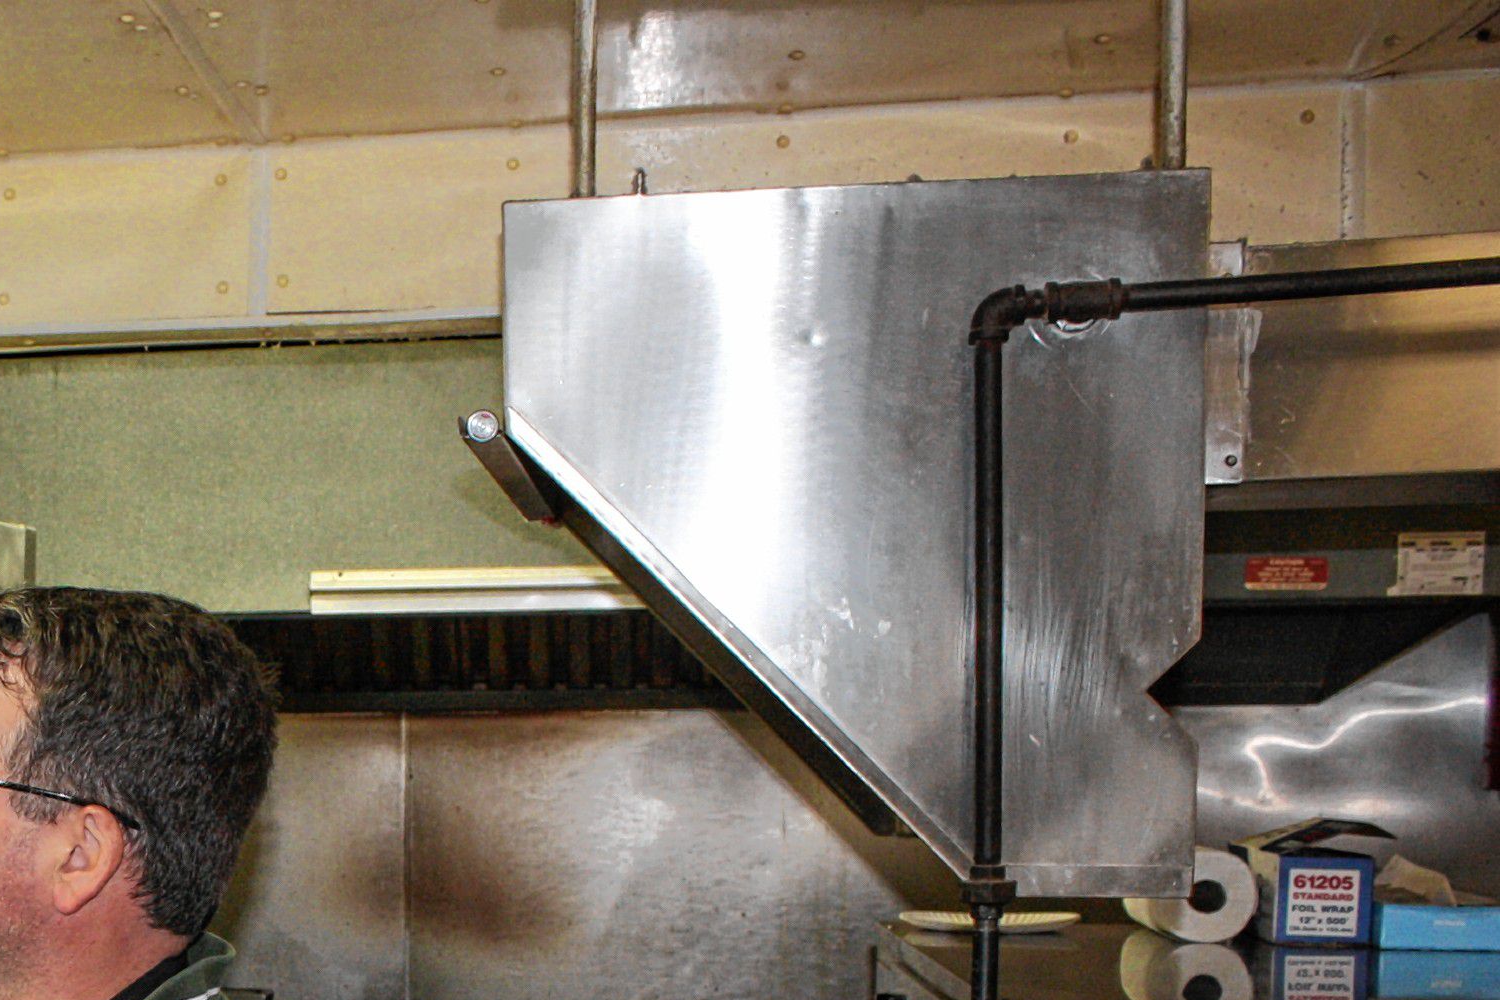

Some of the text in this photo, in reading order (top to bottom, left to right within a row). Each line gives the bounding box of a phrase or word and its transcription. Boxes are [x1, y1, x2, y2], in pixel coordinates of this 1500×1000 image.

[1293, 874, 1354, 891] 61205
[1292, 892, 1354, 902] STANDARD
[1291, 904, 1354, 914] FOIL WRAP
